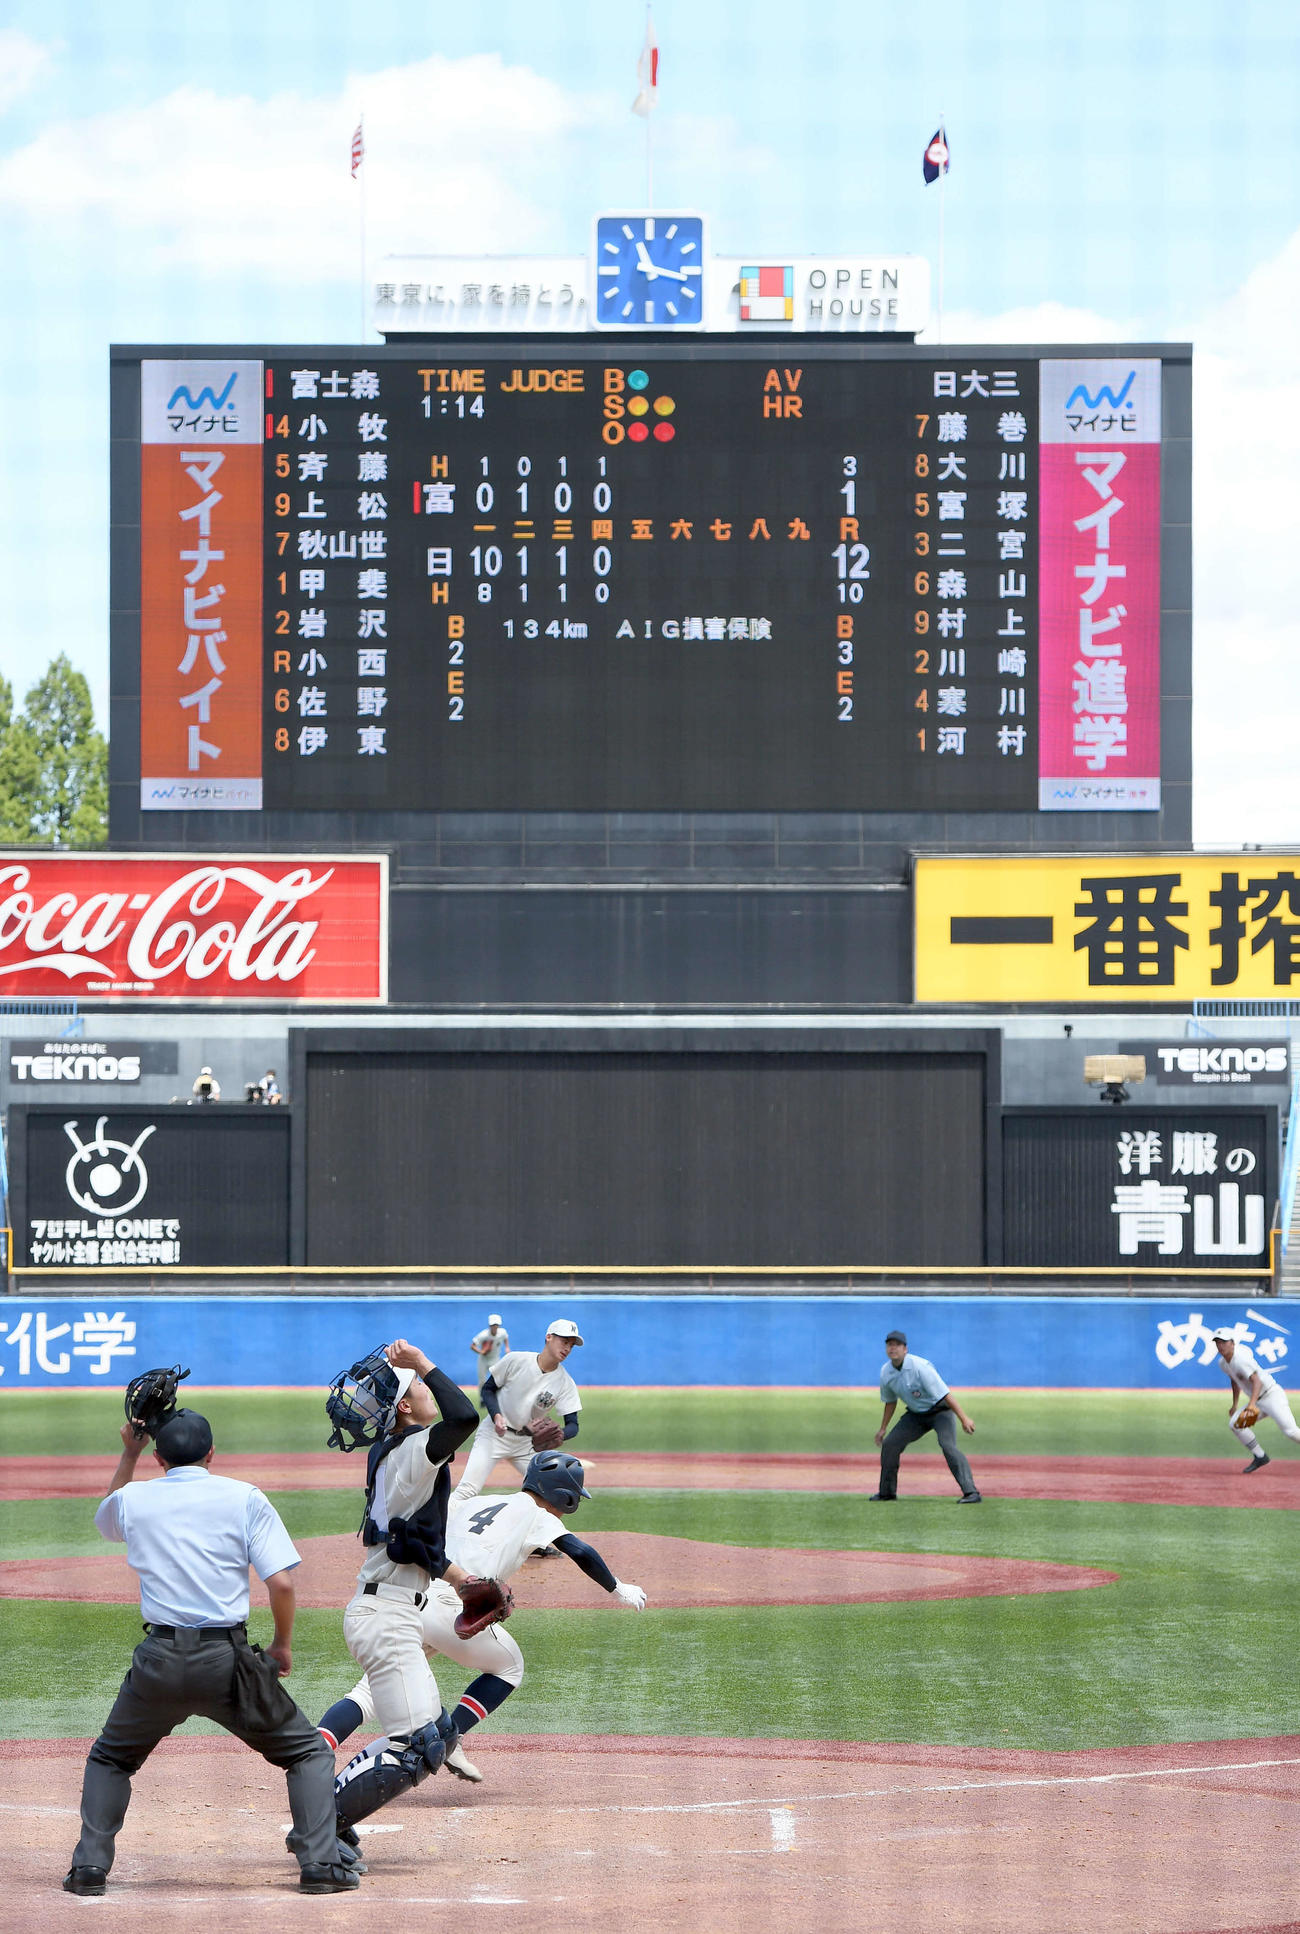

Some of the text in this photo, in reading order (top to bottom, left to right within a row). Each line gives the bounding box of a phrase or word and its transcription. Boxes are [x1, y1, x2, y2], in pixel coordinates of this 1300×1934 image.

[809, 269, 898, 289] OPEN
[376, 283, 587, 305] 東京に、家を持とう。
[810, 299, 898, 316] HOUSE
[291, 369, 380, 400] 富士森
[418, 369, 584, 392] TIME JUDGE
[604, 369, 624, 393] B
[764, 369, 802, 392] AV
[934, 370, 1020, 398] 日大三
[421, 395, 484, 418] 1:14
[604, 395, 625, 419] S
[764, 395, 802, 418] HR
[167, 415, 239, 433] マイナビ
[276, 415, 290, 438] 4
[602, 421, 625, 444] O
[916, 415, 929, 437] 7
[1066, 414, 1136, 432] マイナビ
[276, 454, 290, 477] 5
[432, 456, 857, 477] H 1 0 1 1 3
[915, 454, 929, 477] 8
[275, 493, 290, 516] 9
[423, 481, 855, 515] 富 0 1 0 0 1
[915, 493, 929, 516] 5
[513, 521, 535, 538] 二
[552, 520, 574, 539] 三
[592, 520, 612, 540] 四
[631, 520, 653, 539] 五
[670, 519, 693, 539] 六
[710, 519, 731, 540] 七
[749, 519, 771, 539] 八
[788, 518, 810, 540] 九
[840, 518, 859, 541] R
[276, 530, 387, 560] 7 秋山世
[915, 532, 929, 555] 3
[428, 544, 870, 579] 日 10 1 1 0 12
[278, 572, 286, 594] 1
[432, 582, 863, 604] H 8 1 1 0 10
[915, 572, 929, 594] 6
[176, 451, 228, 772] マイナビバイト
[1072, 450, 1128, 771] マイナビ進学
[276, 611, 289, 634] 2
[448, 616, 464, 638] B
[837, 615, 853, 638] B
[915, 611, 929, 634] 9
[274, 651, 290, 672] R
[449, 641, 464, 665] 2
[838, 641, 853, 664] 3
[915, 650, 929, 673] 2
[448, 671, 464, 694] E
[837, 671, 853, 694] E
[275, 689, 289, 712] 6
[449, 697, 463, 720] 2
[838, 697, 853, 721] 2
[915, 689, 929, 712] 4
[275, 728, 289, 751] 8
[918, 729, 925, 752] 1
[11, 1056, 141, 1080] TEKNOS
[1157, 1048, 1287, 1071] TEKNOS
[1117, 1131, 1256, 1175] 洋服の
[1110, 1179, 1265, 1255] 青山
[30, 1219, 180, 1239] フジテレビONEで
[468, 1502, 508, 1535] 4
